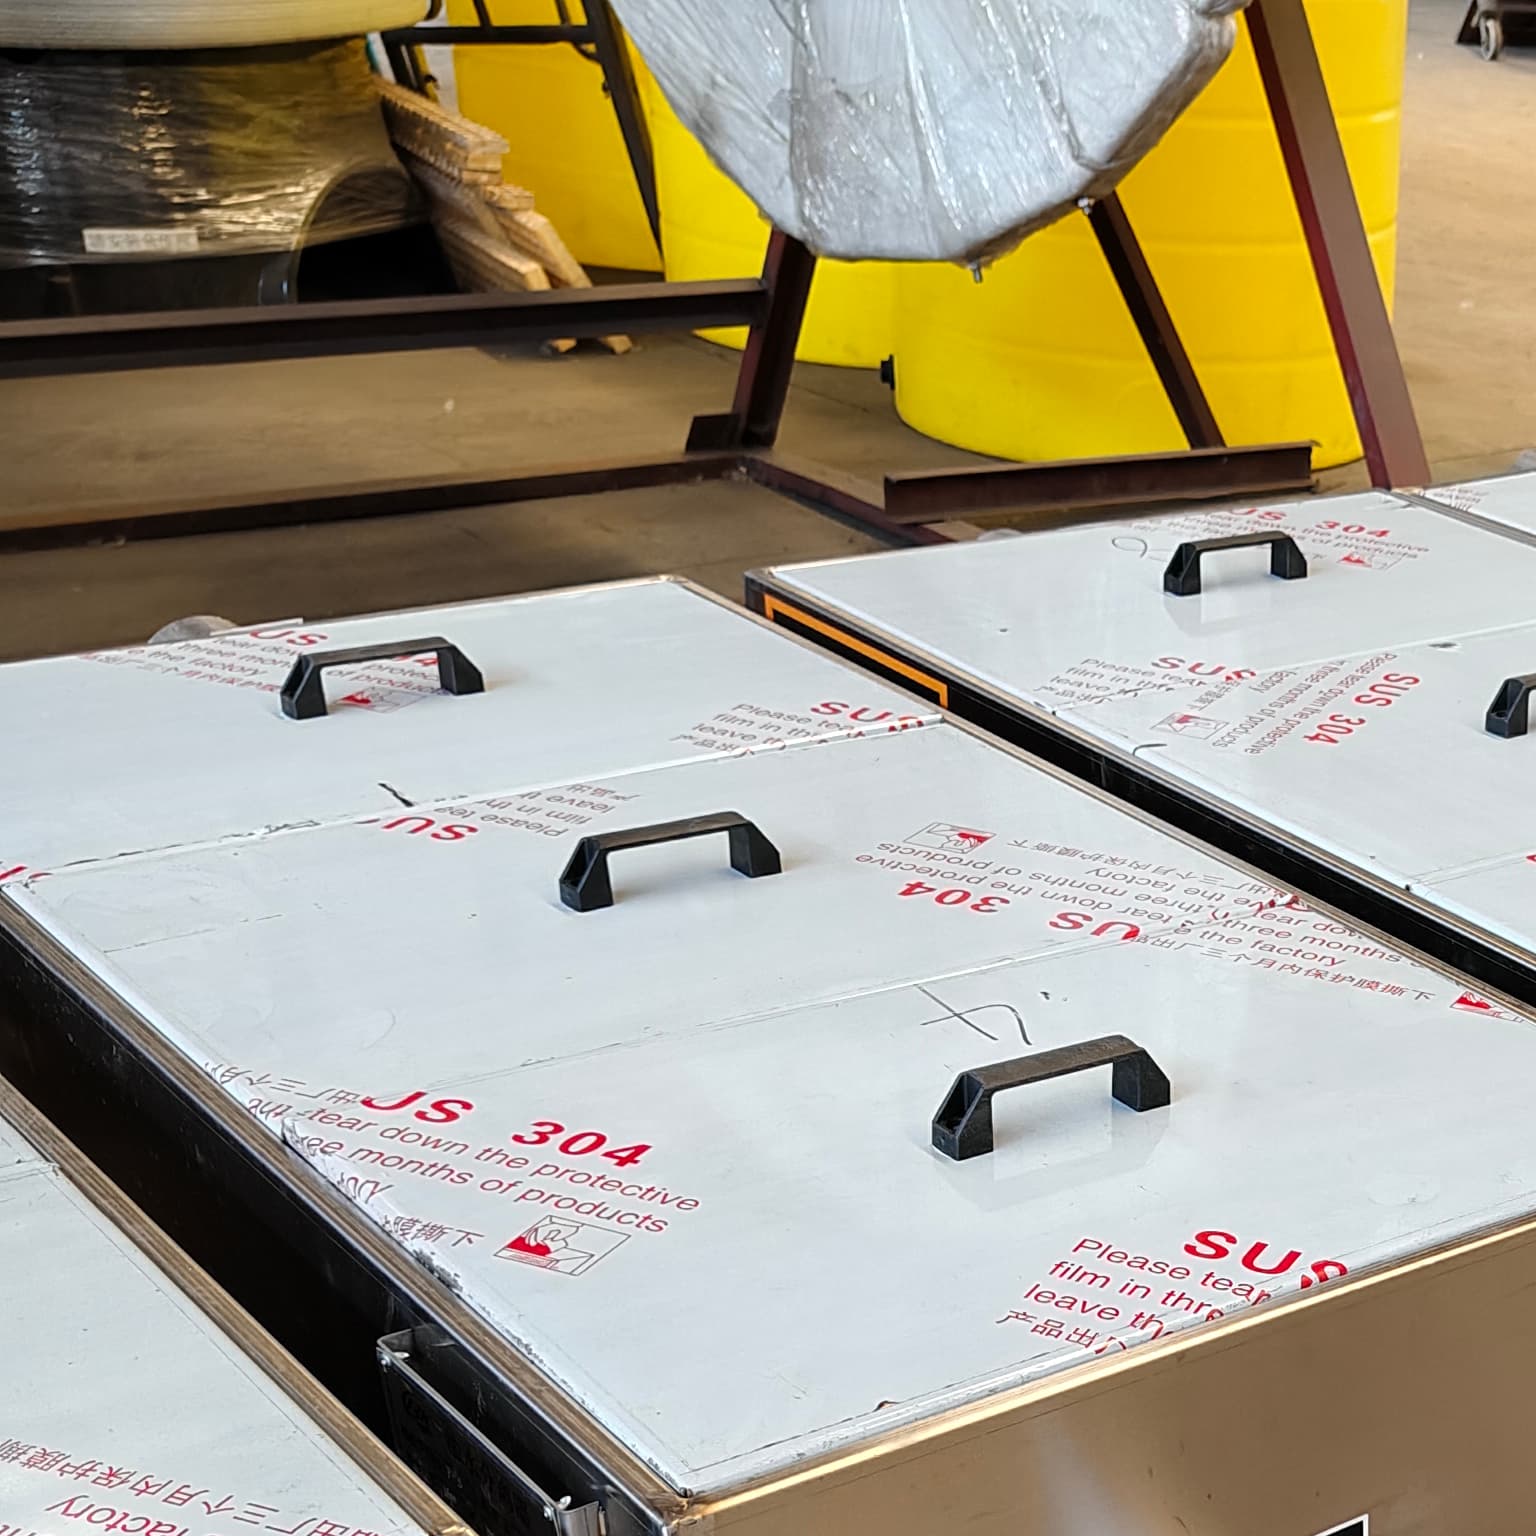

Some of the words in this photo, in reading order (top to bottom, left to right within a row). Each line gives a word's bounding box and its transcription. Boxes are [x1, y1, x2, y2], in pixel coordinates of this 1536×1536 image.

[1316, 520, 1390, 538] 304
[1353, 672, 1421, 708] SUS
[712, 711, 753, 729] film
[759, 720, 783, 734] in
[731, 702, 813, 725] Please
[1303, 713, 1367, 745] 304
[692, 722, 758, 743] leave
[480, 814, 570, 838] Please
[855, 852, 989, 885] protective
[876, 841, 996, 873] products
[993, 865, 1023, 879] of
[990, 879, 1034, 897] the
[1027, 869, 1128, 899] months
[1085, 866, 1177, 893] factory
[1183, 886, 1227, 903] the
[896, 881, 1011, 915] 304
[1039, 889, 1114, 913] down
[1133, 890, 1203, 916] three
[1116, 904, 1174, 926] tear
[1199, 929, 1244, 947] the
[1248, 938, 1348, 969] factory
[1221, 918, 1294, 940] three
[1298, 934, 1403, 965] months
[510, 1120, 654, 1168] 304
[378, 1126, 471, 1156] down
[473, 1146, 531, 1170] the
[527, 1162, 702, 1212] protective
[347, 1147, 476, 1186] months
[479, 1176, 525, 1196] of
[512, 1186, 671, 1234] products
[1048, 1260, 1111, 1290] film
[1118, 1278, 1153, 1300] in
[1071, 1237, 1192, 1281] Please
[1198, 1269, 1274, 1307] tear
[1023, 1283, 1122, 1322] leave
